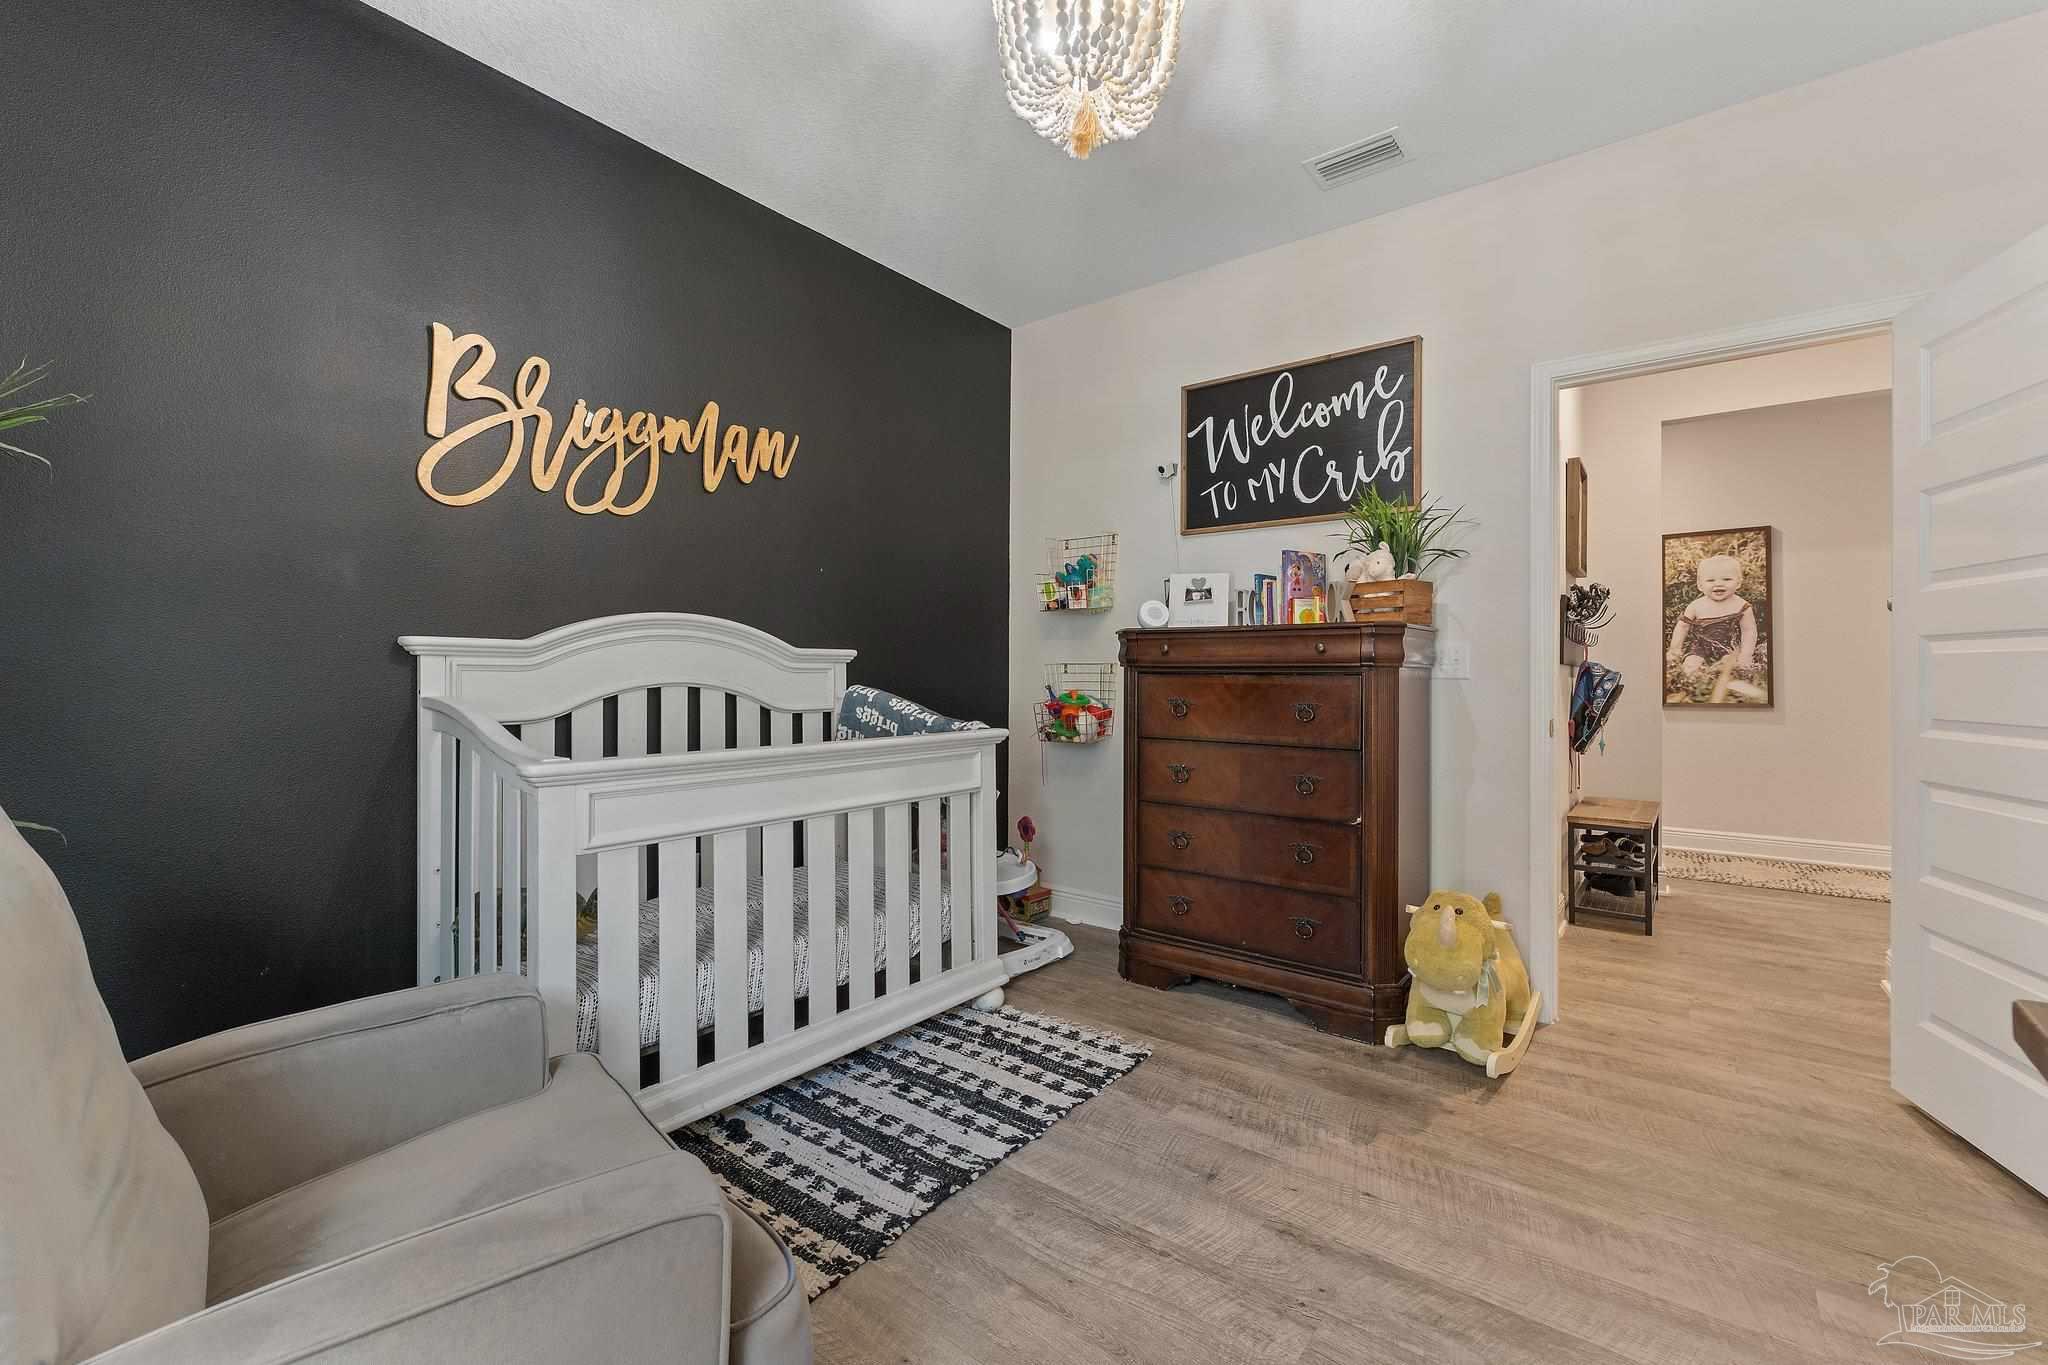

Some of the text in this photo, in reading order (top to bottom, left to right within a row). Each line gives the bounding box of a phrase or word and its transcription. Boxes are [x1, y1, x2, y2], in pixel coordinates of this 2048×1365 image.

[1187, 365, 1404, 473] Welcome
[1200, 399, 1413, 519] TO MY Crib
[855, 705, 899, 737] briggs
[888, 697, 938, 726] briggs
